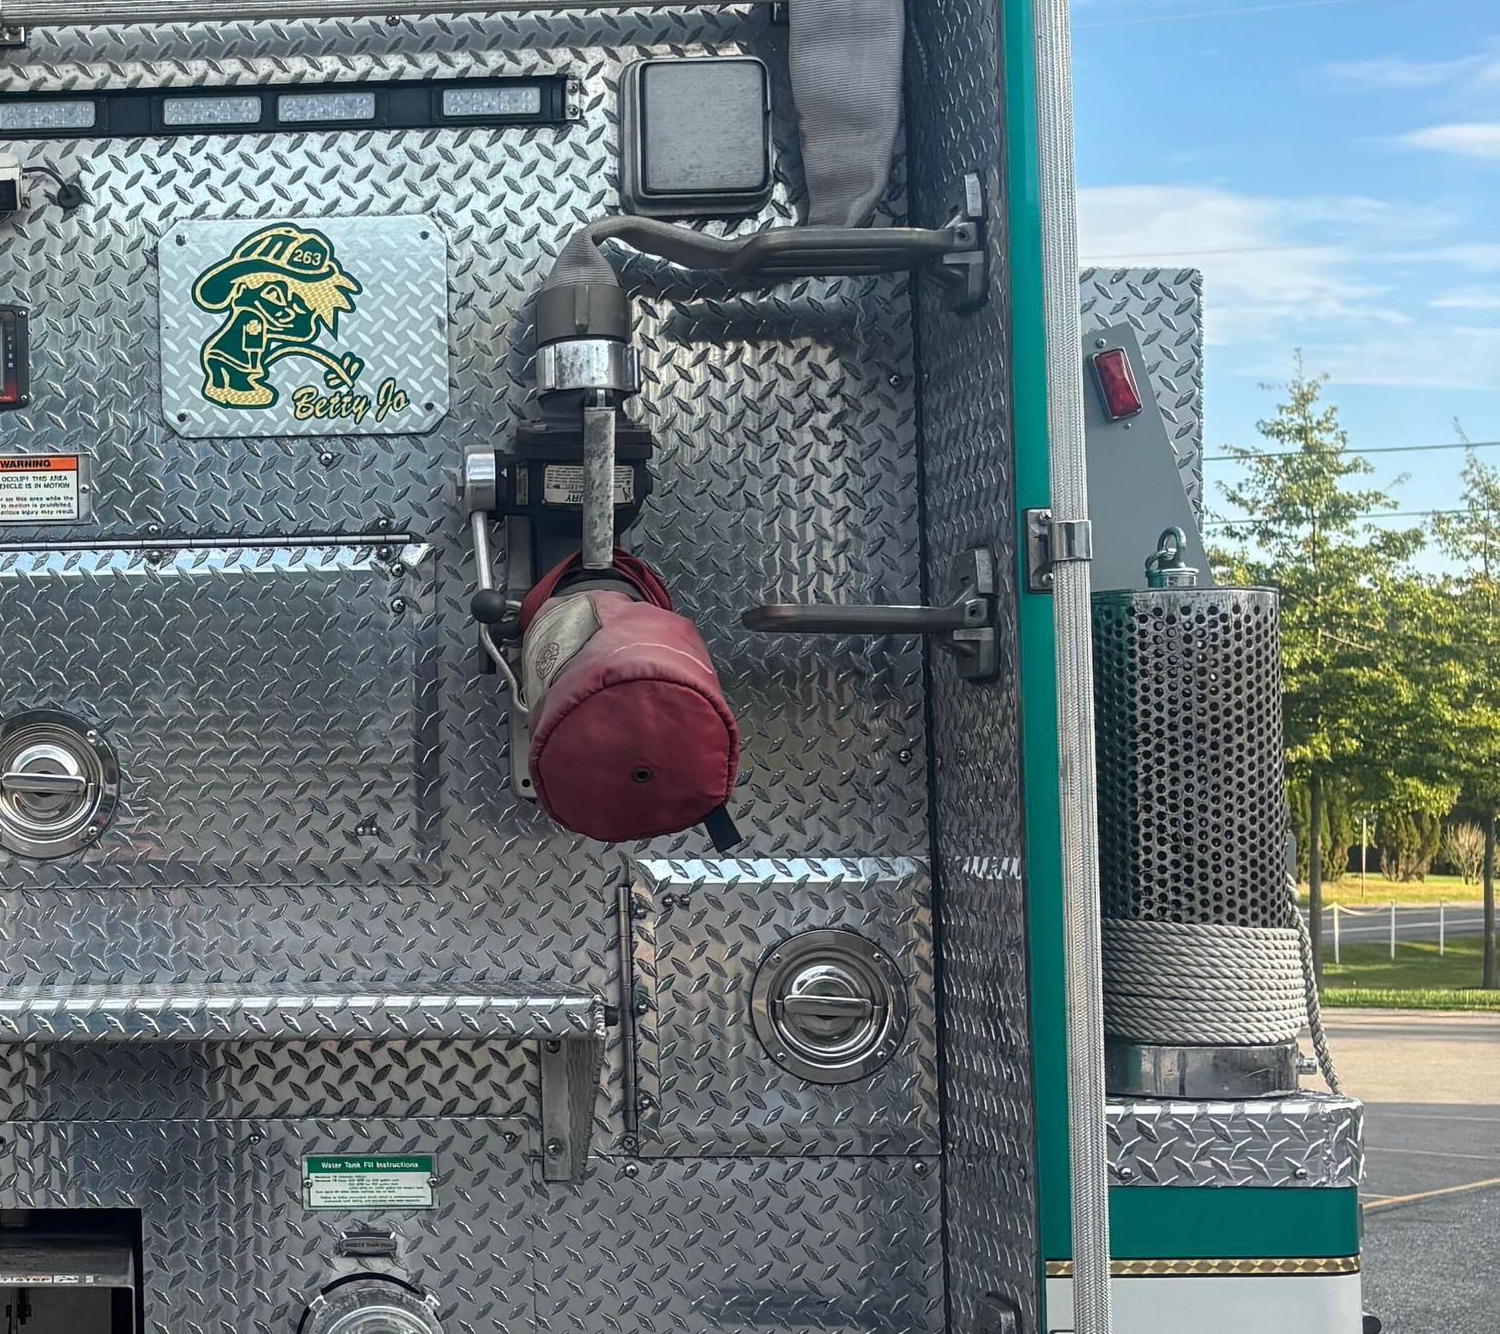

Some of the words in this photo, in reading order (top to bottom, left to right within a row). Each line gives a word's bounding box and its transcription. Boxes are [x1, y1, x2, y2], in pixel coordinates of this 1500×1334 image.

[294, 248, 321, 266] 263
[292, 384, 370, 423] Betty
[375, 377, 410, 420] Jo
[0, 459, 51, 468] WARNING
